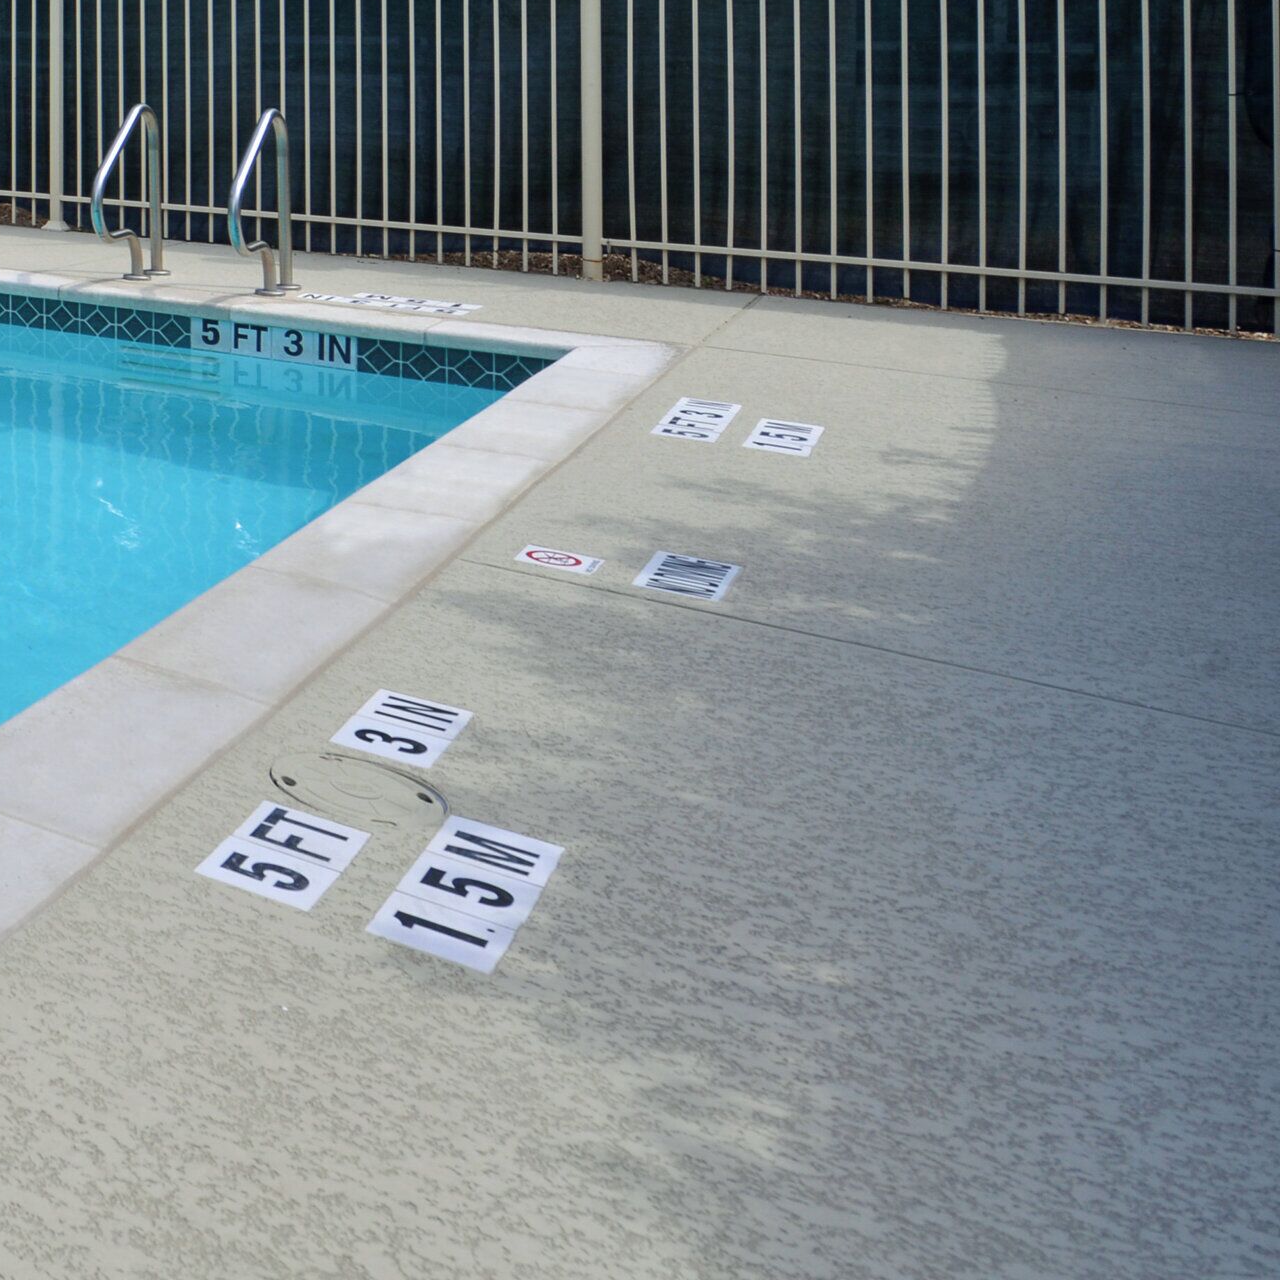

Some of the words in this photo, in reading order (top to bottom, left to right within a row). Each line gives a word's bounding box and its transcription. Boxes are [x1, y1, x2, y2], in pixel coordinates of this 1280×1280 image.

[201, 318, 220, 346] 5
[233, 323, 268, 353] FT
[283, 329, 304, 357] 3
[318, 332, 351, 365] IN
[668, 416, 719, 431] FT
[679, 409, 724, 419] 3
[662, 428, 710, 439] 5
[374, 695, 460, 732] IN
[354, 728, 429, 755] 3
[250, 807, 349, 863] FT
[221, 851, 311, 892] 5
